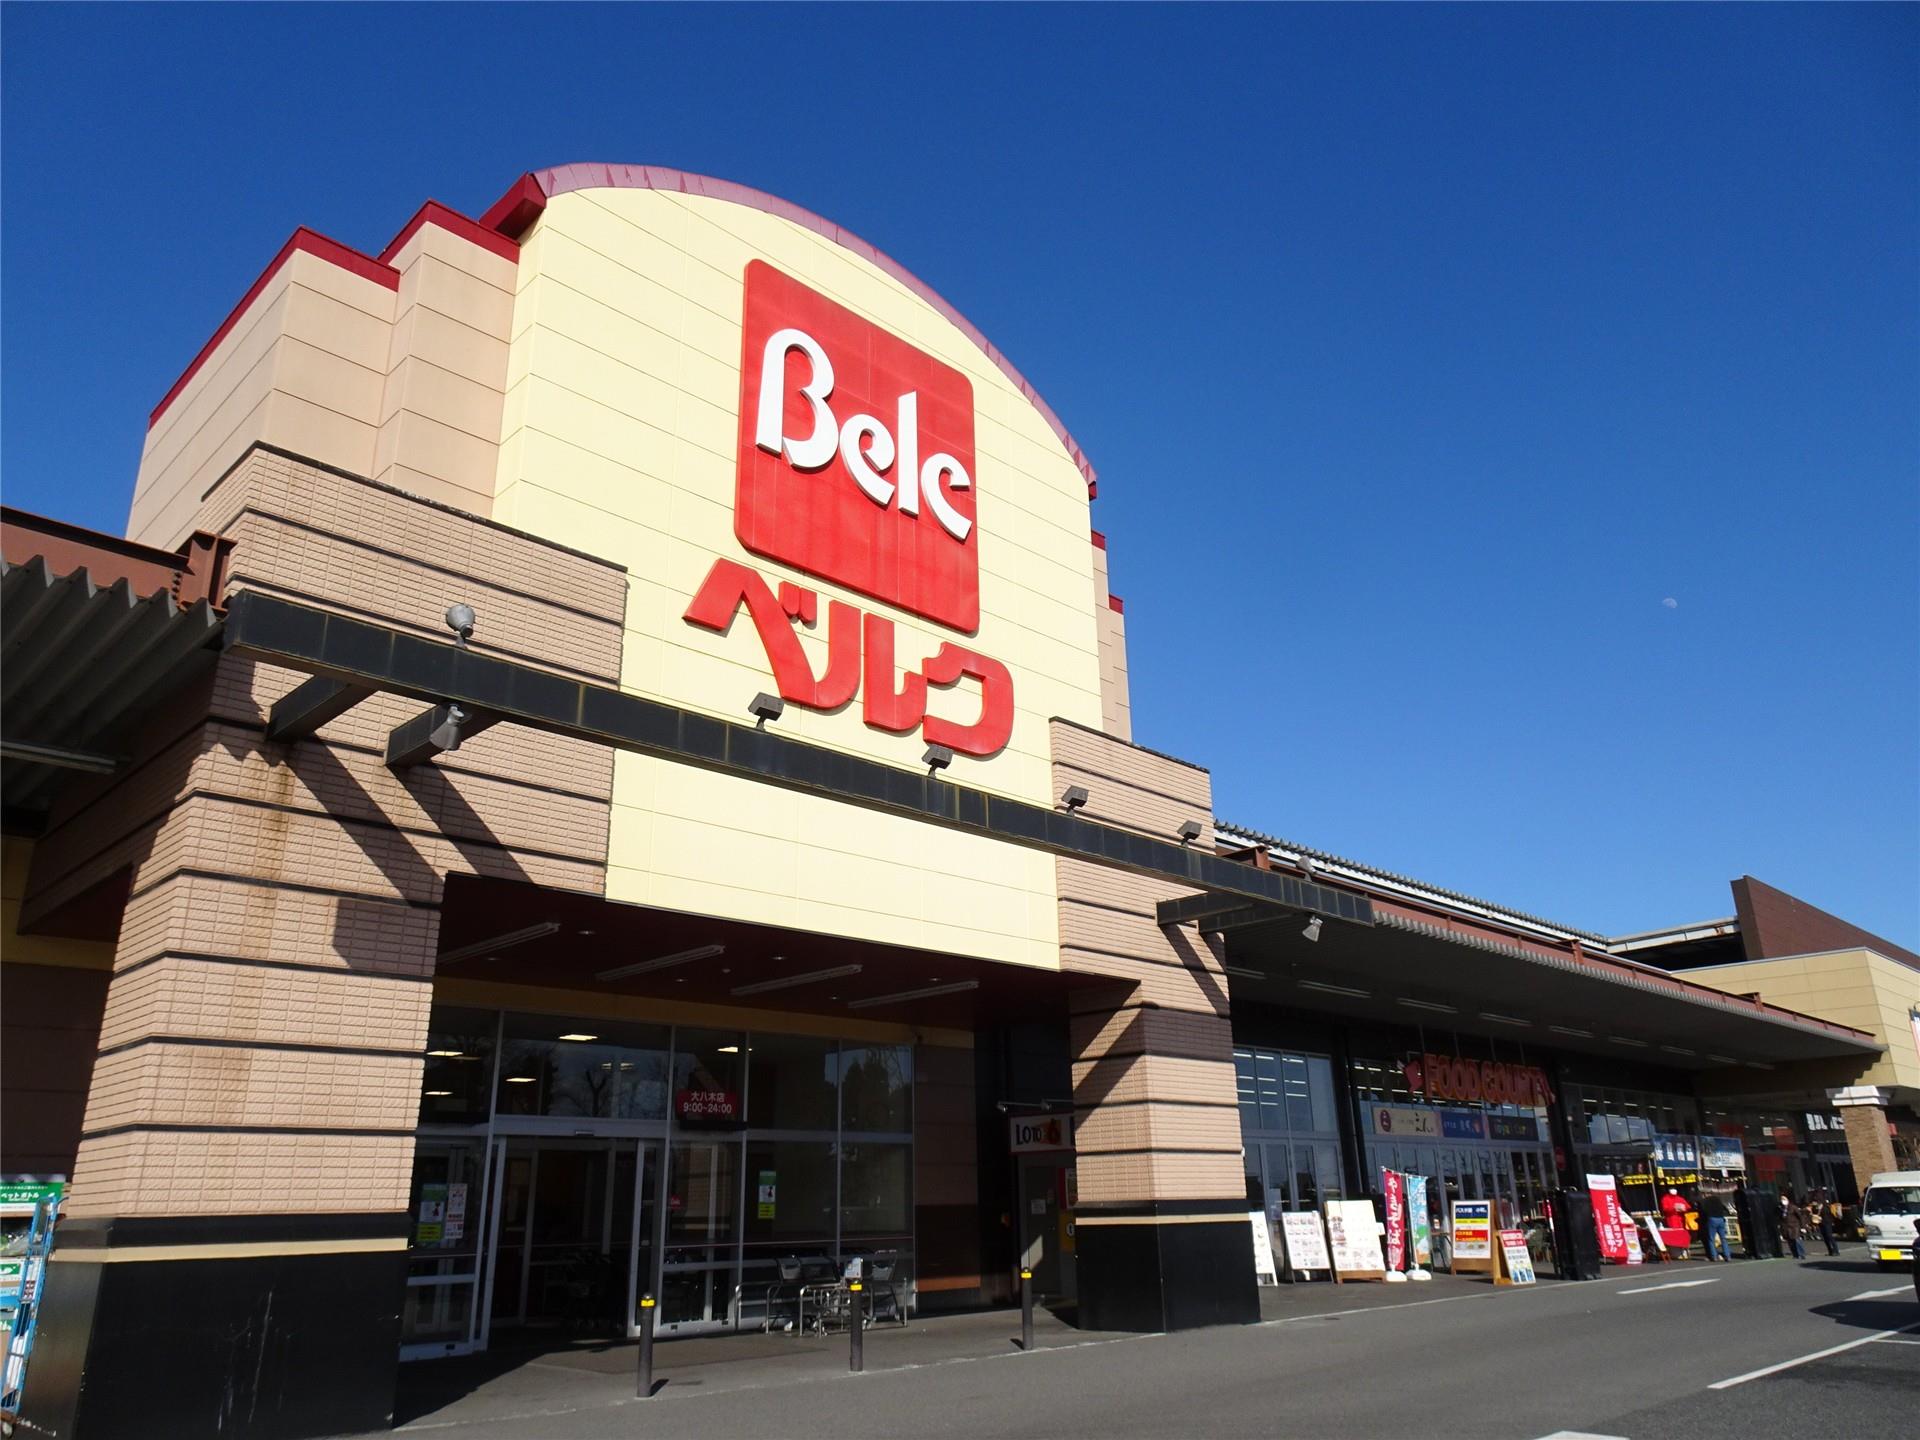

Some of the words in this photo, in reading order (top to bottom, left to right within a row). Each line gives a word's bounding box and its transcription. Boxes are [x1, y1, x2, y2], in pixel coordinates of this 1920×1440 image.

[682, 557, 1015, 757] ベルク
[1423, 1052, 1480, 1100] FOOD
[691, 1091, 725, 1102] 大八木店
[1016, 1124, 1043, 1146] LOTO
